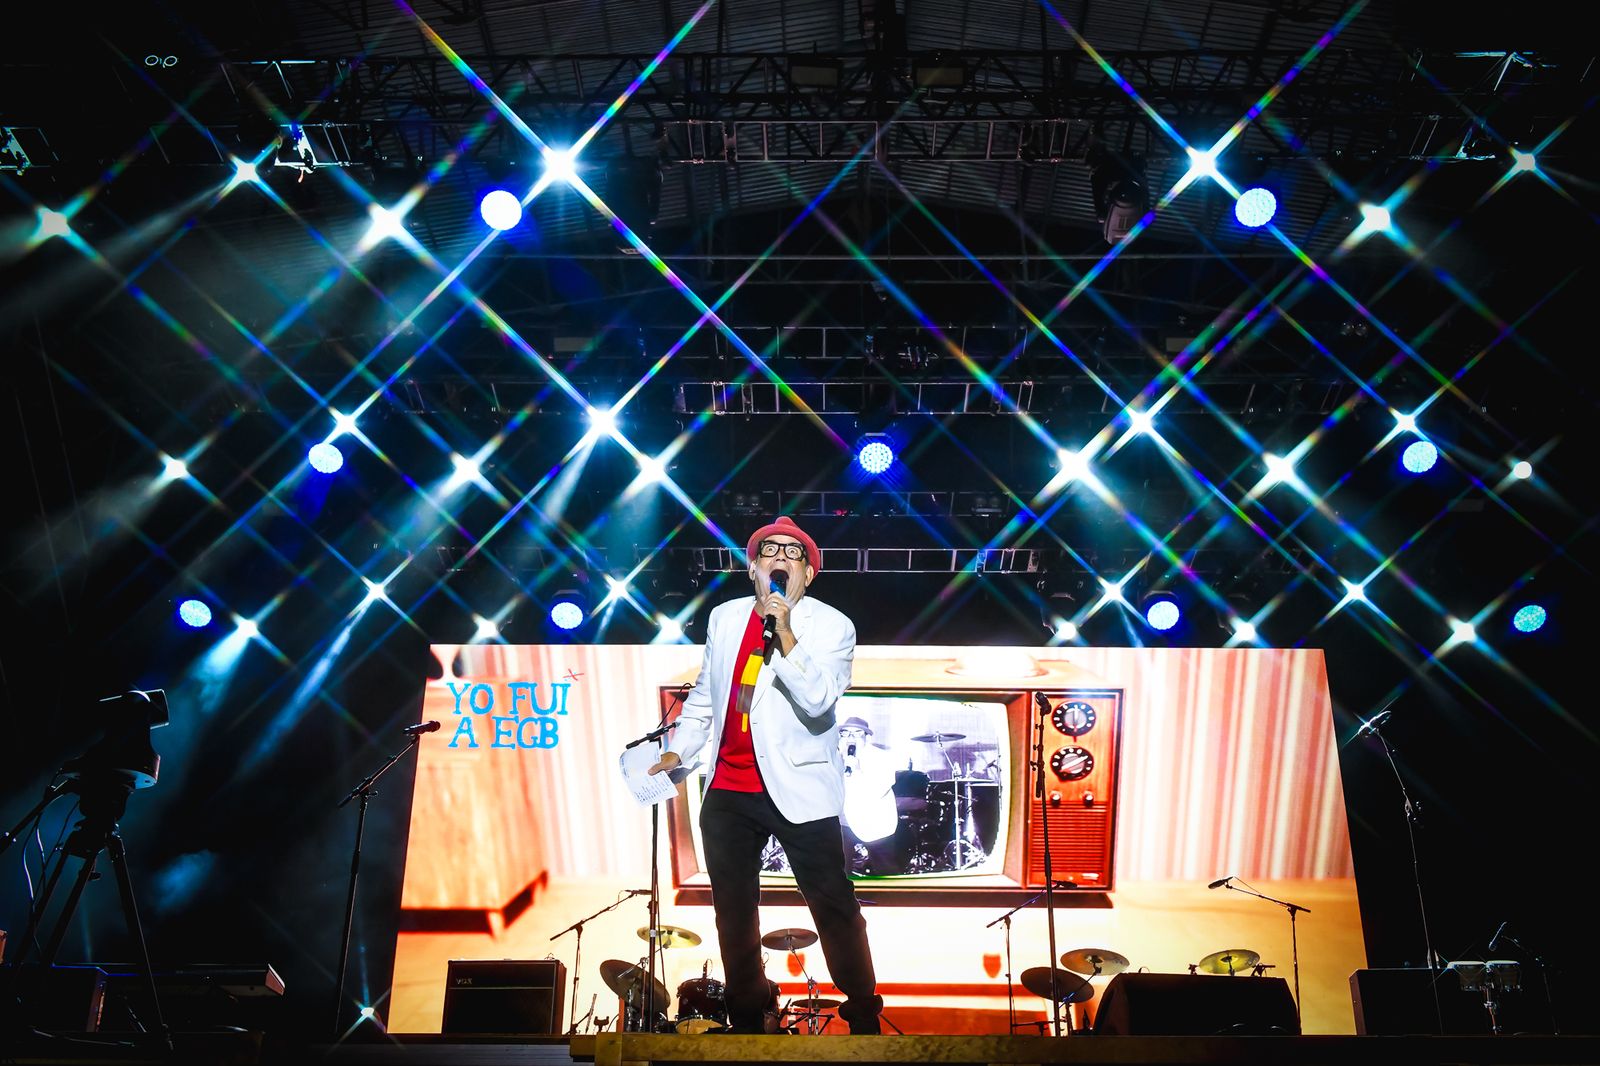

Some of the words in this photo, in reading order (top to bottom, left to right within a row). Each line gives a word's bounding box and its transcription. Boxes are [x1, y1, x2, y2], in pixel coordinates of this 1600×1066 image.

[447, 682, 494, 714] YO
[508, 682, 571, 715] FUI
[448, 717, 479, 748] A
[491, 716, 559, 749] EGB
